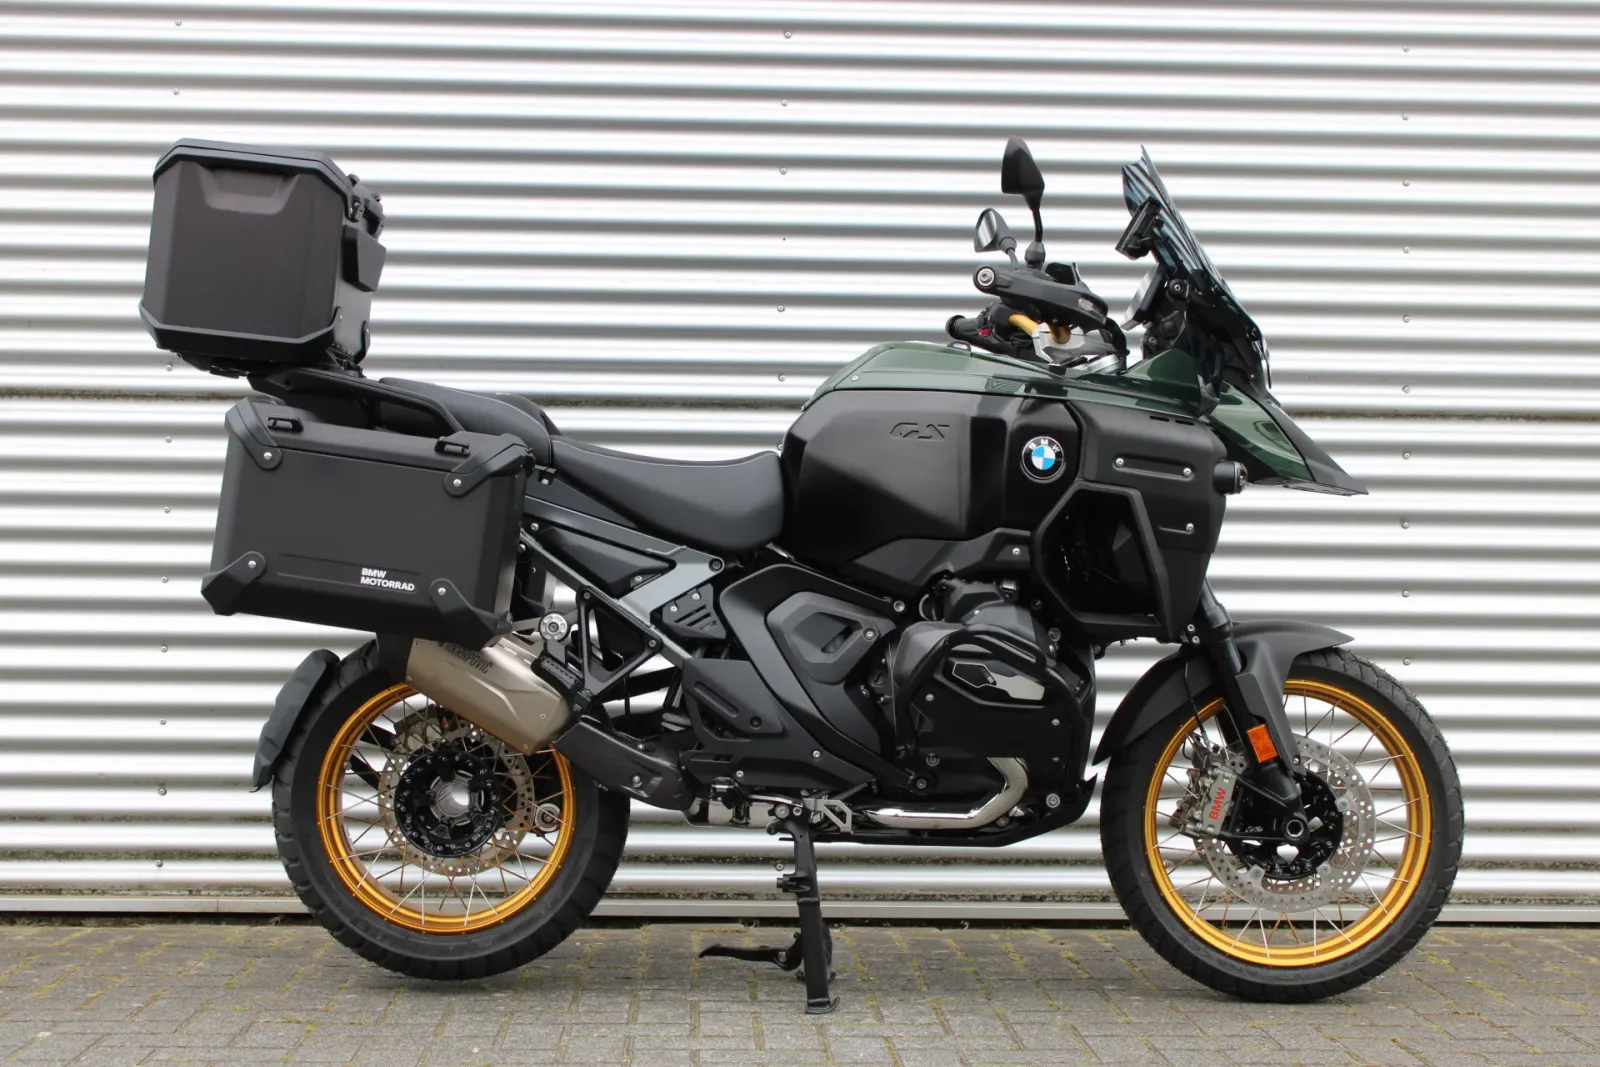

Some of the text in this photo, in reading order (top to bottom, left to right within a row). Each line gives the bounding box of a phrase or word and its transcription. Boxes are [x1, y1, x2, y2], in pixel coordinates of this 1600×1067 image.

[1028, 438, 1061, 453] BMW
[361, 567, 387, 578] BMW
[360, 576, 415, 591] MOTORRAD
[1208, 787, 1226, 820] BMW
